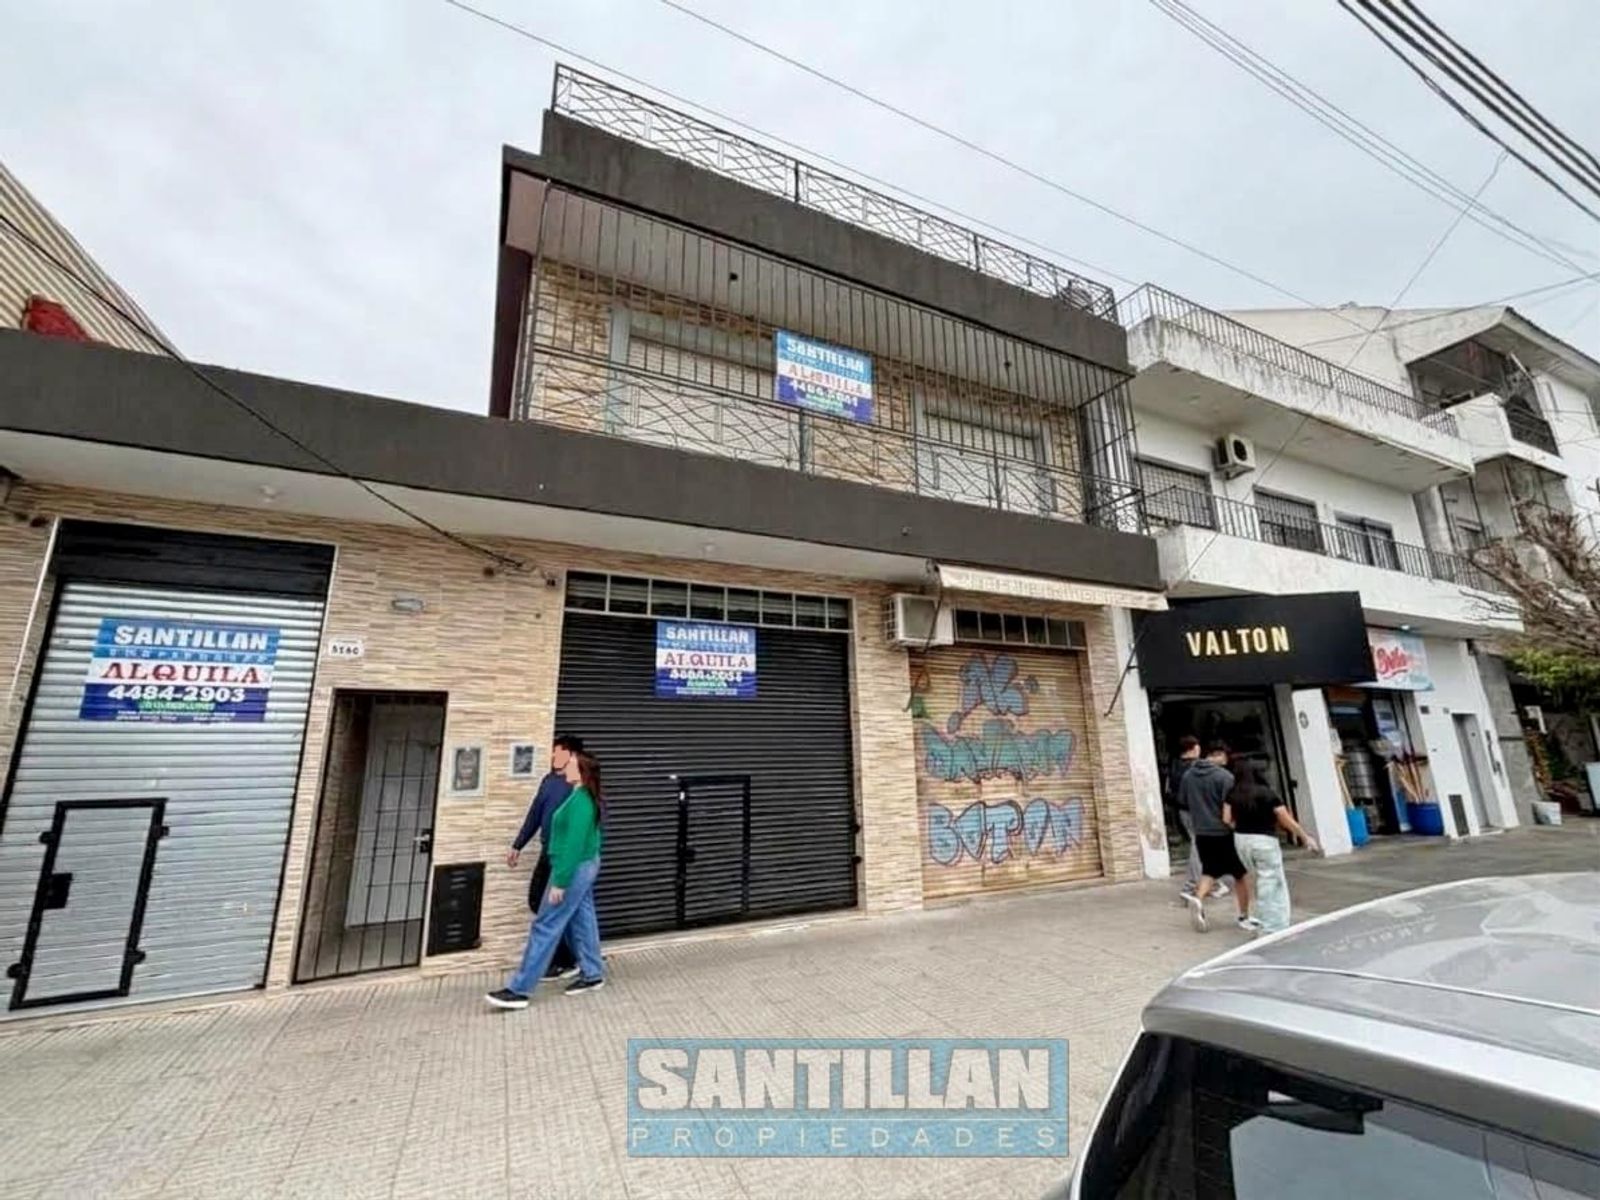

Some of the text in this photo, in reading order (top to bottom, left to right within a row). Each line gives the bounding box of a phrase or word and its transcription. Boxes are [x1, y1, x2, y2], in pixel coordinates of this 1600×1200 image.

[114, 625, 268, 650] SANTILLAN
[665, 626, 750, 644] SANTILLAN
[1186, 626, 1290, 657] VALTON
[664, 652, 749, 668] ALQUILA
[102, 662, 261, 684] ALQUILA
[107, 685, 246, 702] 4484-2903
